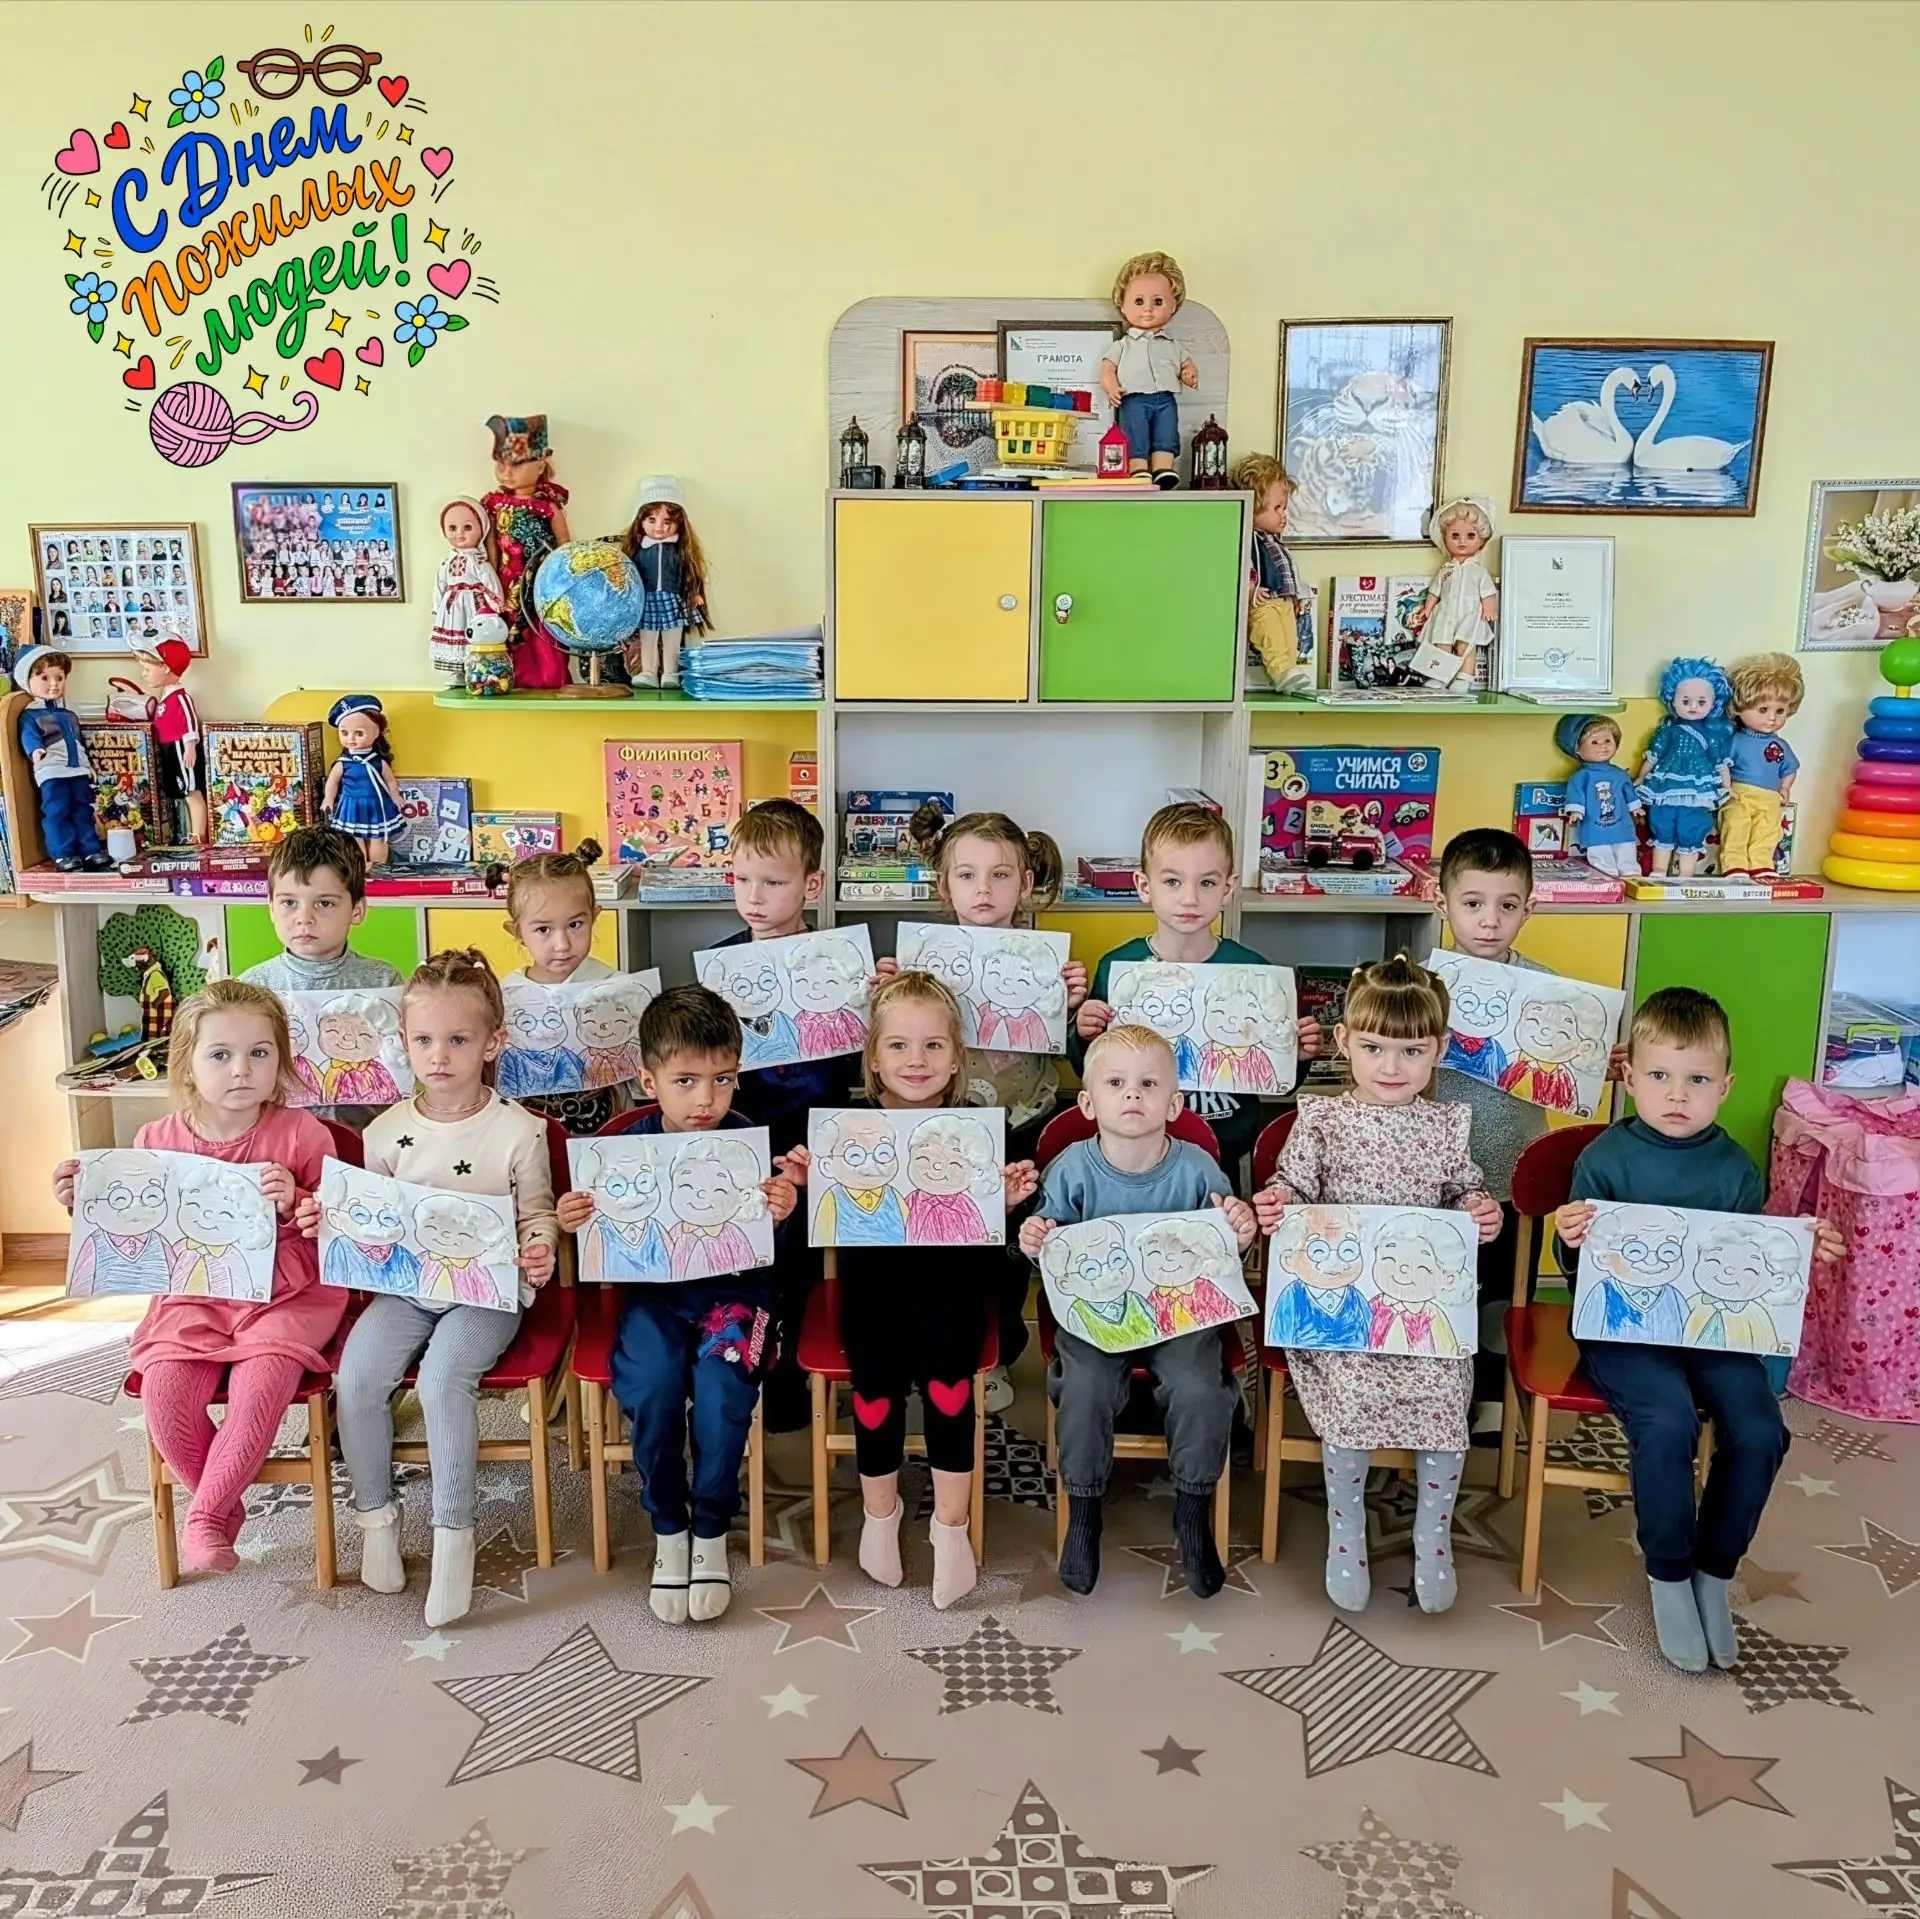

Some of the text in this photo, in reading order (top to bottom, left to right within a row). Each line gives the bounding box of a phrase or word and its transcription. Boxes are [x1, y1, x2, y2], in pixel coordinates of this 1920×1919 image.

[1037, 354, 1083, 363] ГРАМОТА
[1336, 757, 1401, 773] УЧИМСЯ
[1335, 773, 1400, 790] СЧИТАТЬ
[1681, 888, 1725, 898] ЧИСЛА
